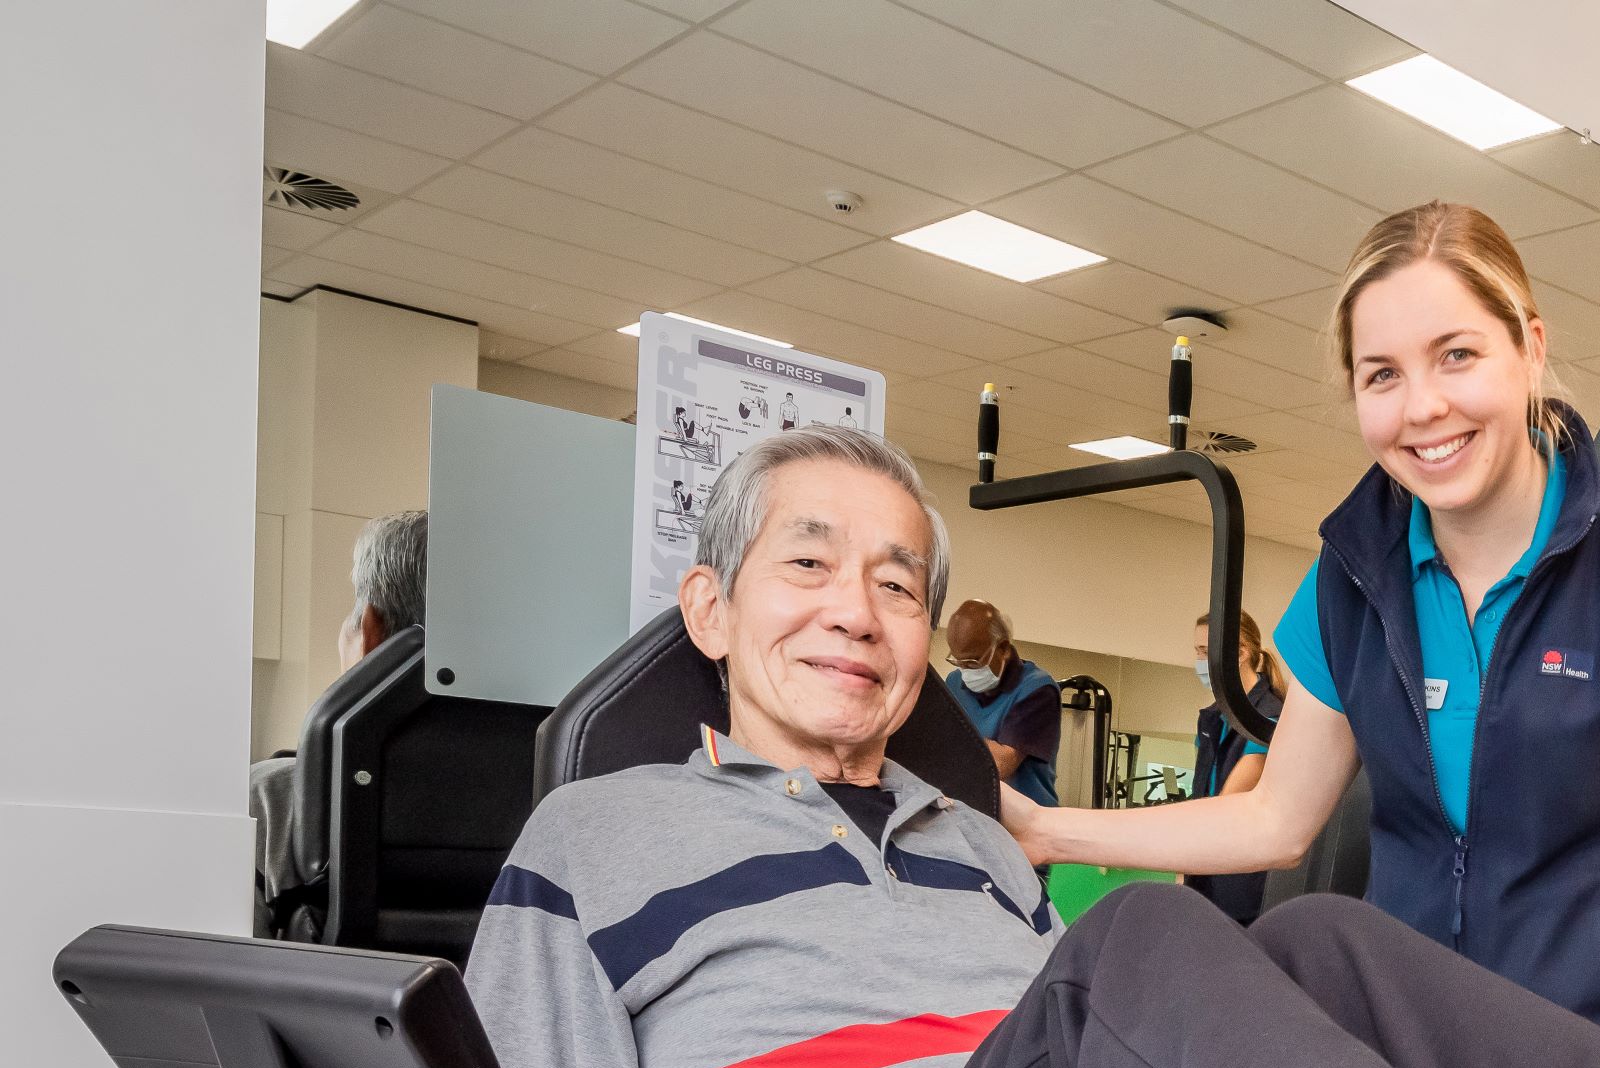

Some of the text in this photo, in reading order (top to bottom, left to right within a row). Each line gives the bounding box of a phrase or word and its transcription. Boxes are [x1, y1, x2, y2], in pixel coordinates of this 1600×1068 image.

[746, 354, 772, 371] LEG
[777, 359, 823, 384] PRESS
[1541, 662, 1589, 679] NSW Health
